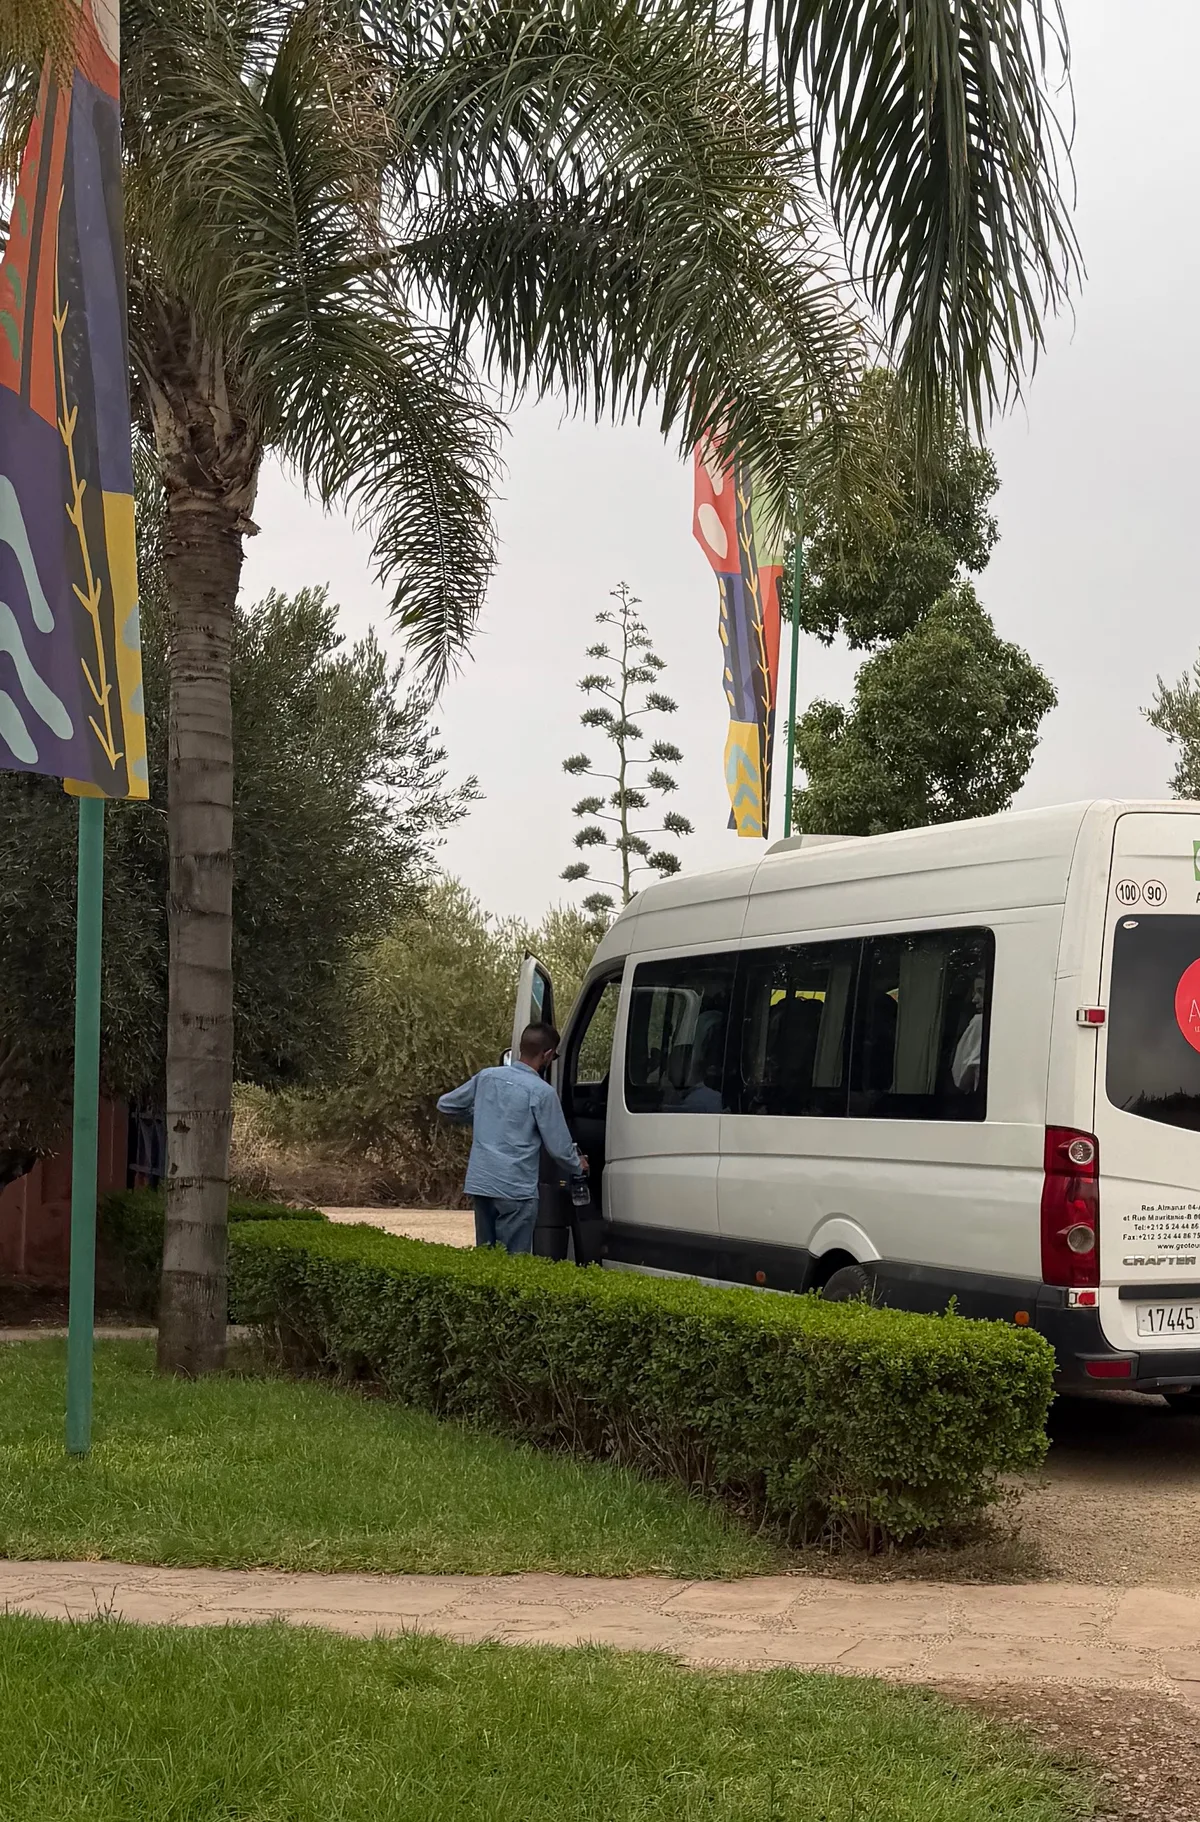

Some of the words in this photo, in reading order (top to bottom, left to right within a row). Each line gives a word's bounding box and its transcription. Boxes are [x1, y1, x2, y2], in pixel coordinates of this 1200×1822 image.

[1119, 884, 1136, 901] 100
[1147, 886, 1162, 901] 90
[1122, 1255, 1197, 1266] CRAFTER
[1148, 1307, 1195, 1332] 17445
